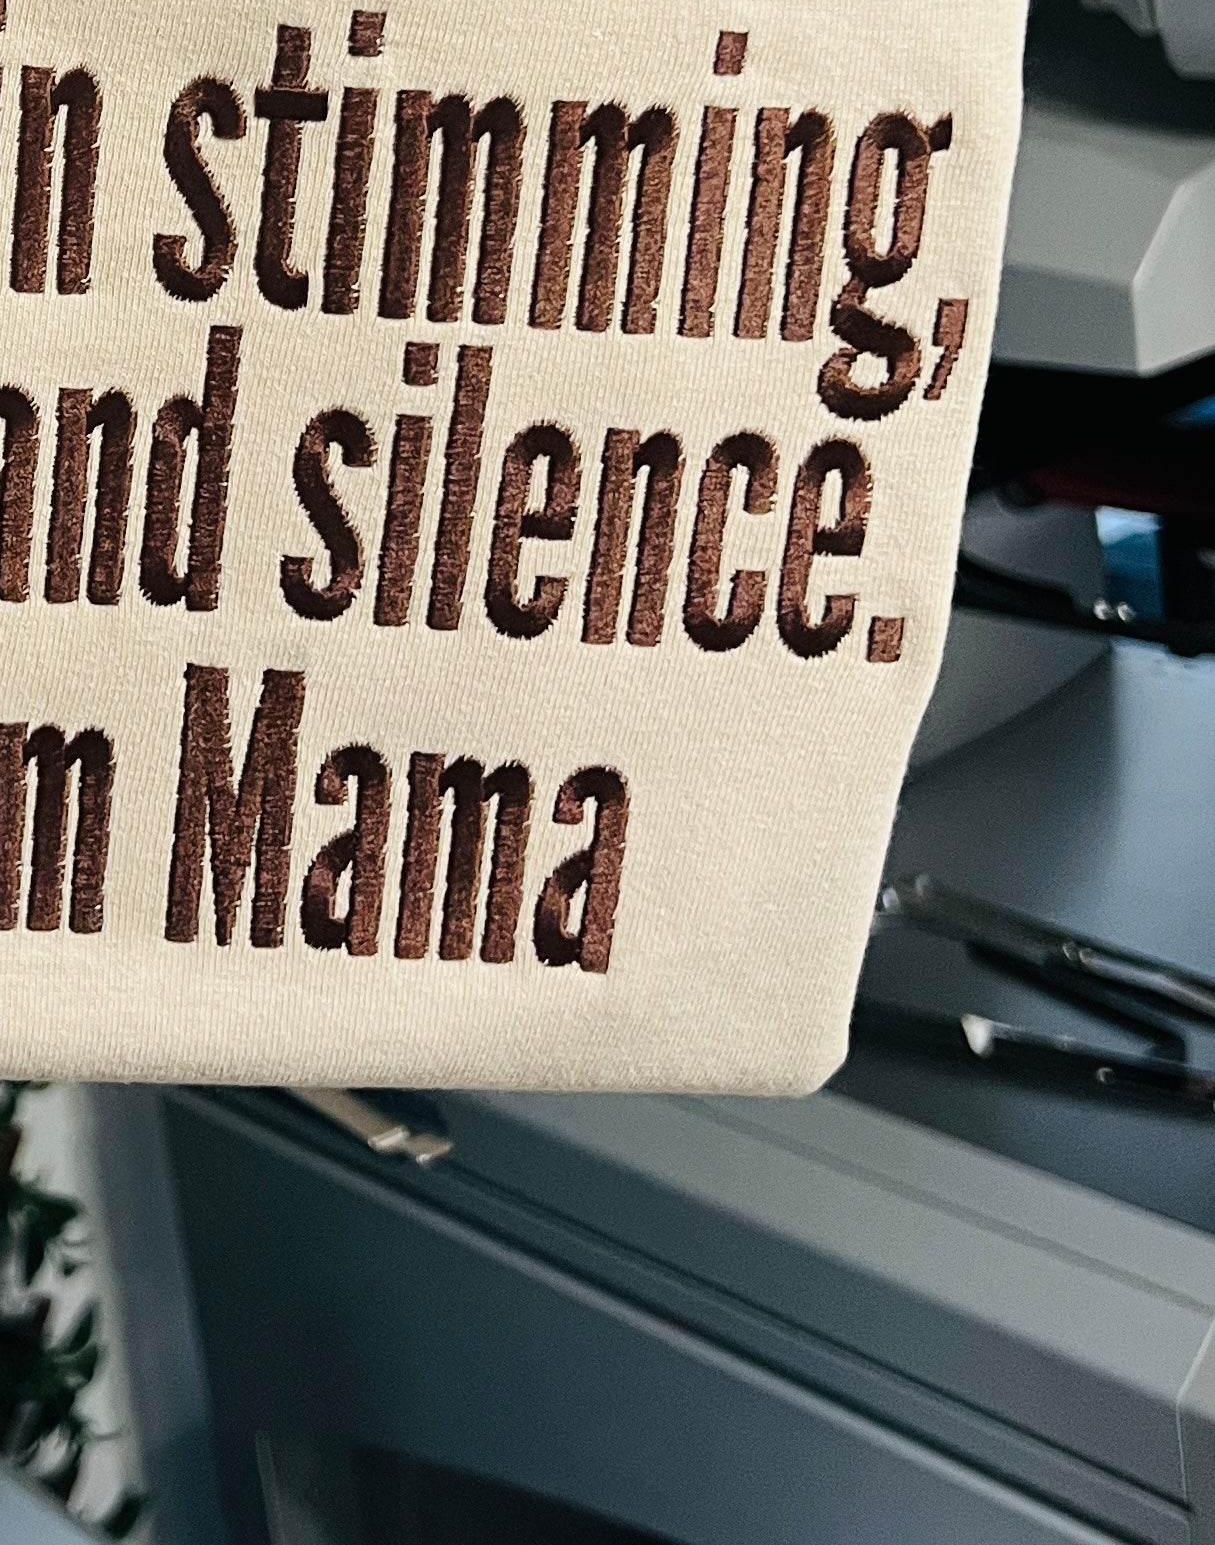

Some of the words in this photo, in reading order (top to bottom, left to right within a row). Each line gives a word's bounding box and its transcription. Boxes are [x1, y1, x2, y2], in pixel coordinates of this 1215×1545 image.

[152, 10, 969, 422] stimming,
[279, 341, 905, 663] silence.
[164, 662, 630, 974] Mama
